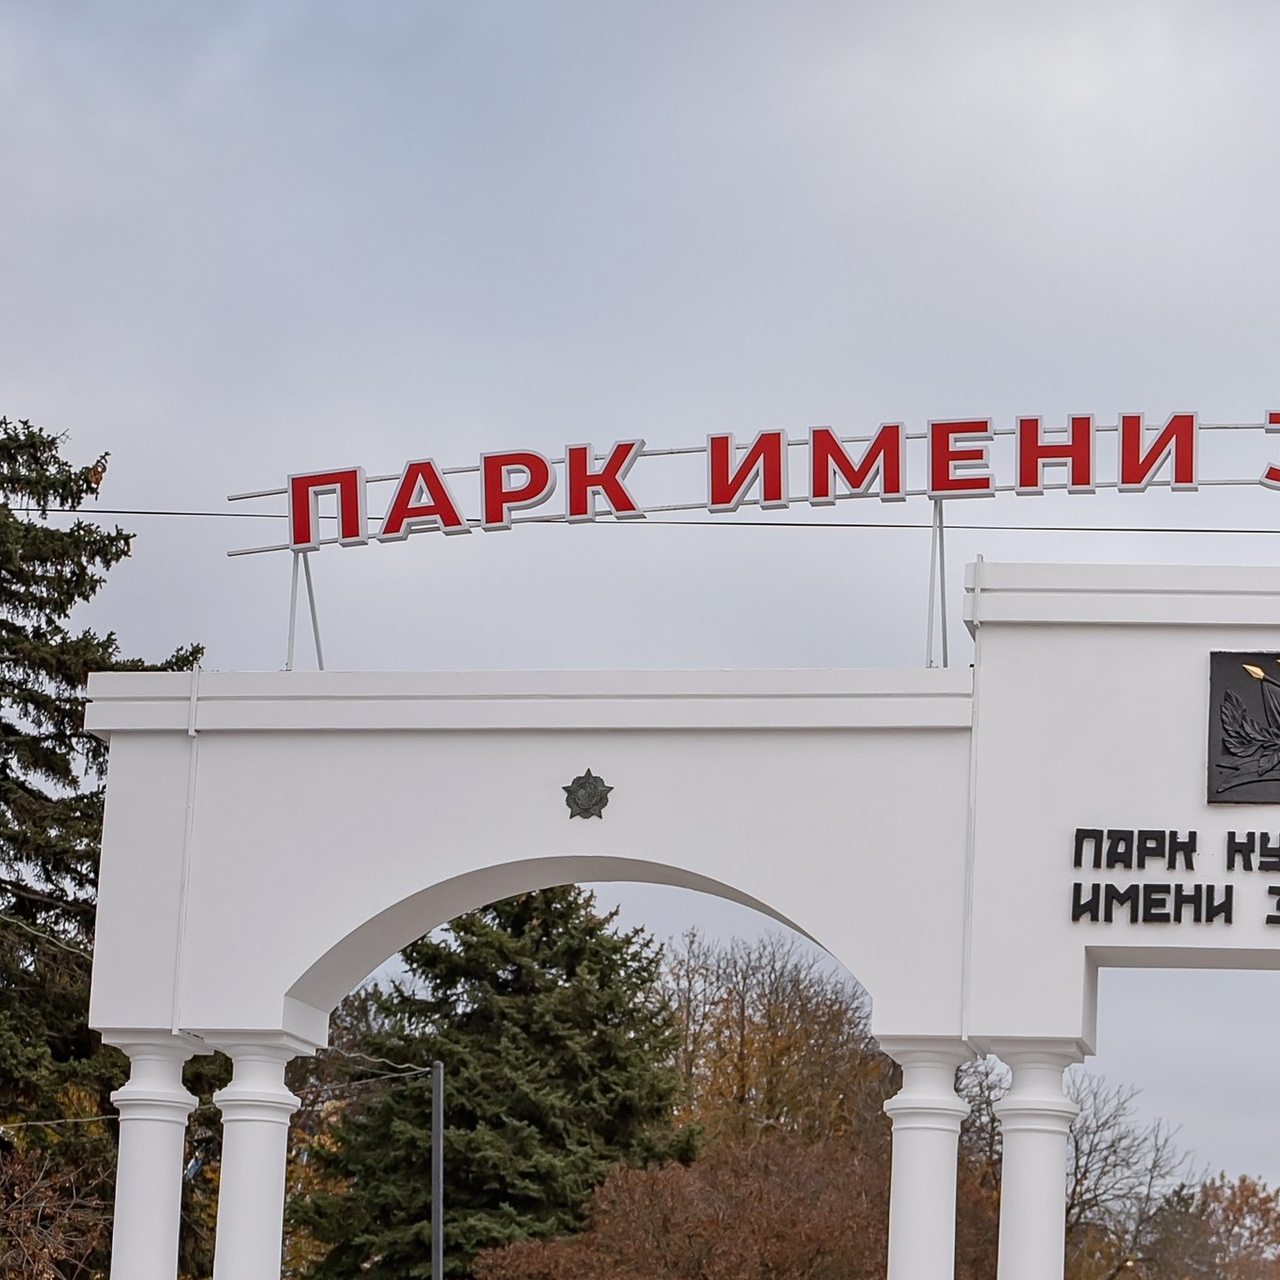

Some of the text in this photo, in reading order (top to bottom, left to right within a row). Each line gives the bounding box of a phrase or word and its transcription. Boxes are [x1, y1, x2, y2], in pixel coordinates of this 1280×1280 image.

[288, 437, 645, 550] ПАРК
[705, 411, 1199, 510] ИМЕНИ
[1073, 828, 1198, 872] ПАРК
[1072, 882, 1234, 925] ИМЕНИ
